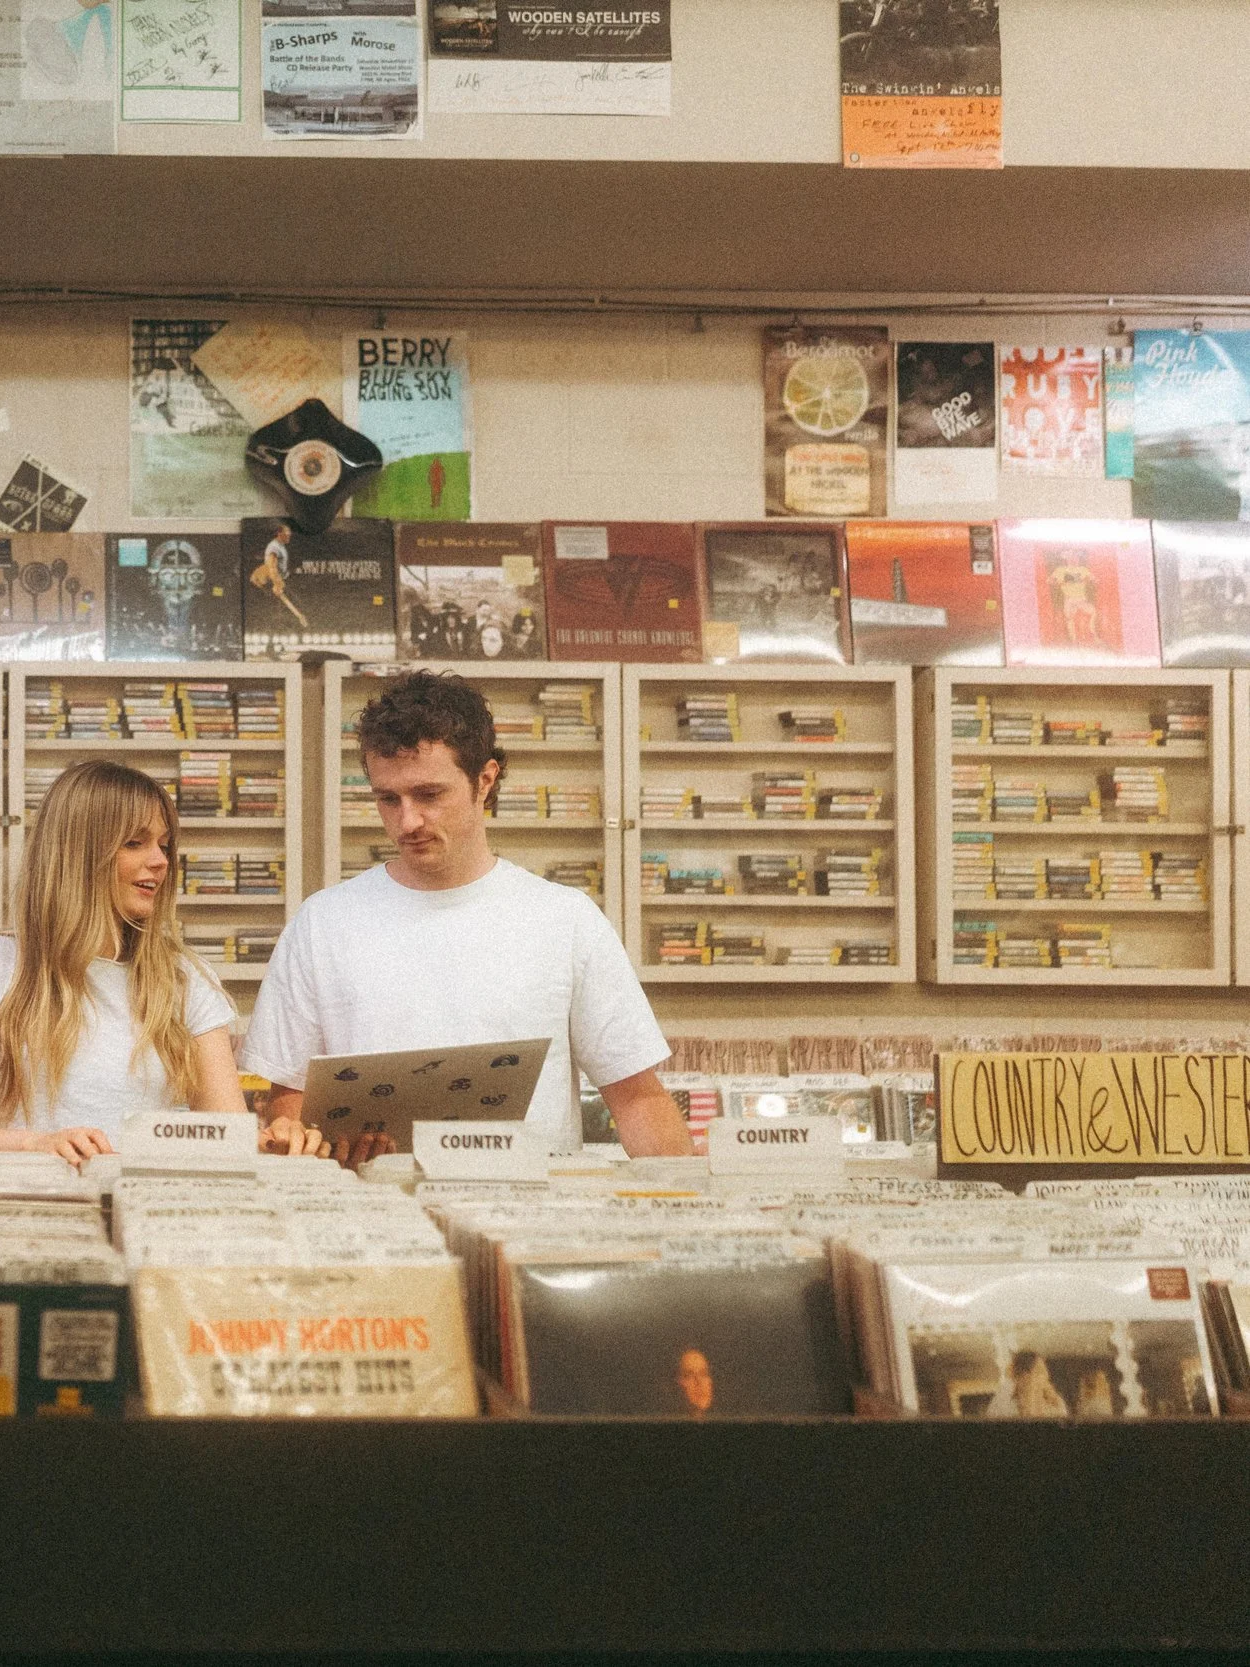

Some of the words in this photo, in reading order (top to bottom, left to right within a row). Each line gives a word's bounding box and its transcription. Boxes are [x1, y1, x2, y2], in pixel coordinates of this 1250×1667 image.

[508, 11, 573, 24] WOODEN
[576, 11, 661, 24] SATELLITES
[275, 30, 338, 50] B-Sharps
[351, 37, 396, 51] Morose
[270, 55, 292, 63] Battle
[300, 64, 330, 72] Release
[332, 64, 353, 73] Party
[842, 82, 867, 94] The
[876, 82, 941, 95] Swingin'
[950, 83, 1000, 95] Angels
[358, 338, 451, 368] BERRY
[1144, 339, 1198, 365] Pink
[359, 368, 406, 388] BLUE
[413, 368, 451, 388] SKY
[358, 384, 413, 401] RAGING
[421, 383, 452, 401] SUN
[931, 391, 972, 420] GOOD
[941, 411, 982, 441] WAVE
[951, 1057, 1087, 1157] COUNTRY
[154, 1123, 227, 1140] COUNTRY
[737, 1128, 809, 1144] COUNTRY
[440, 1134, 513, 1151] COUNTRY
[296, 1316, 430, 1352] HORTON'S
